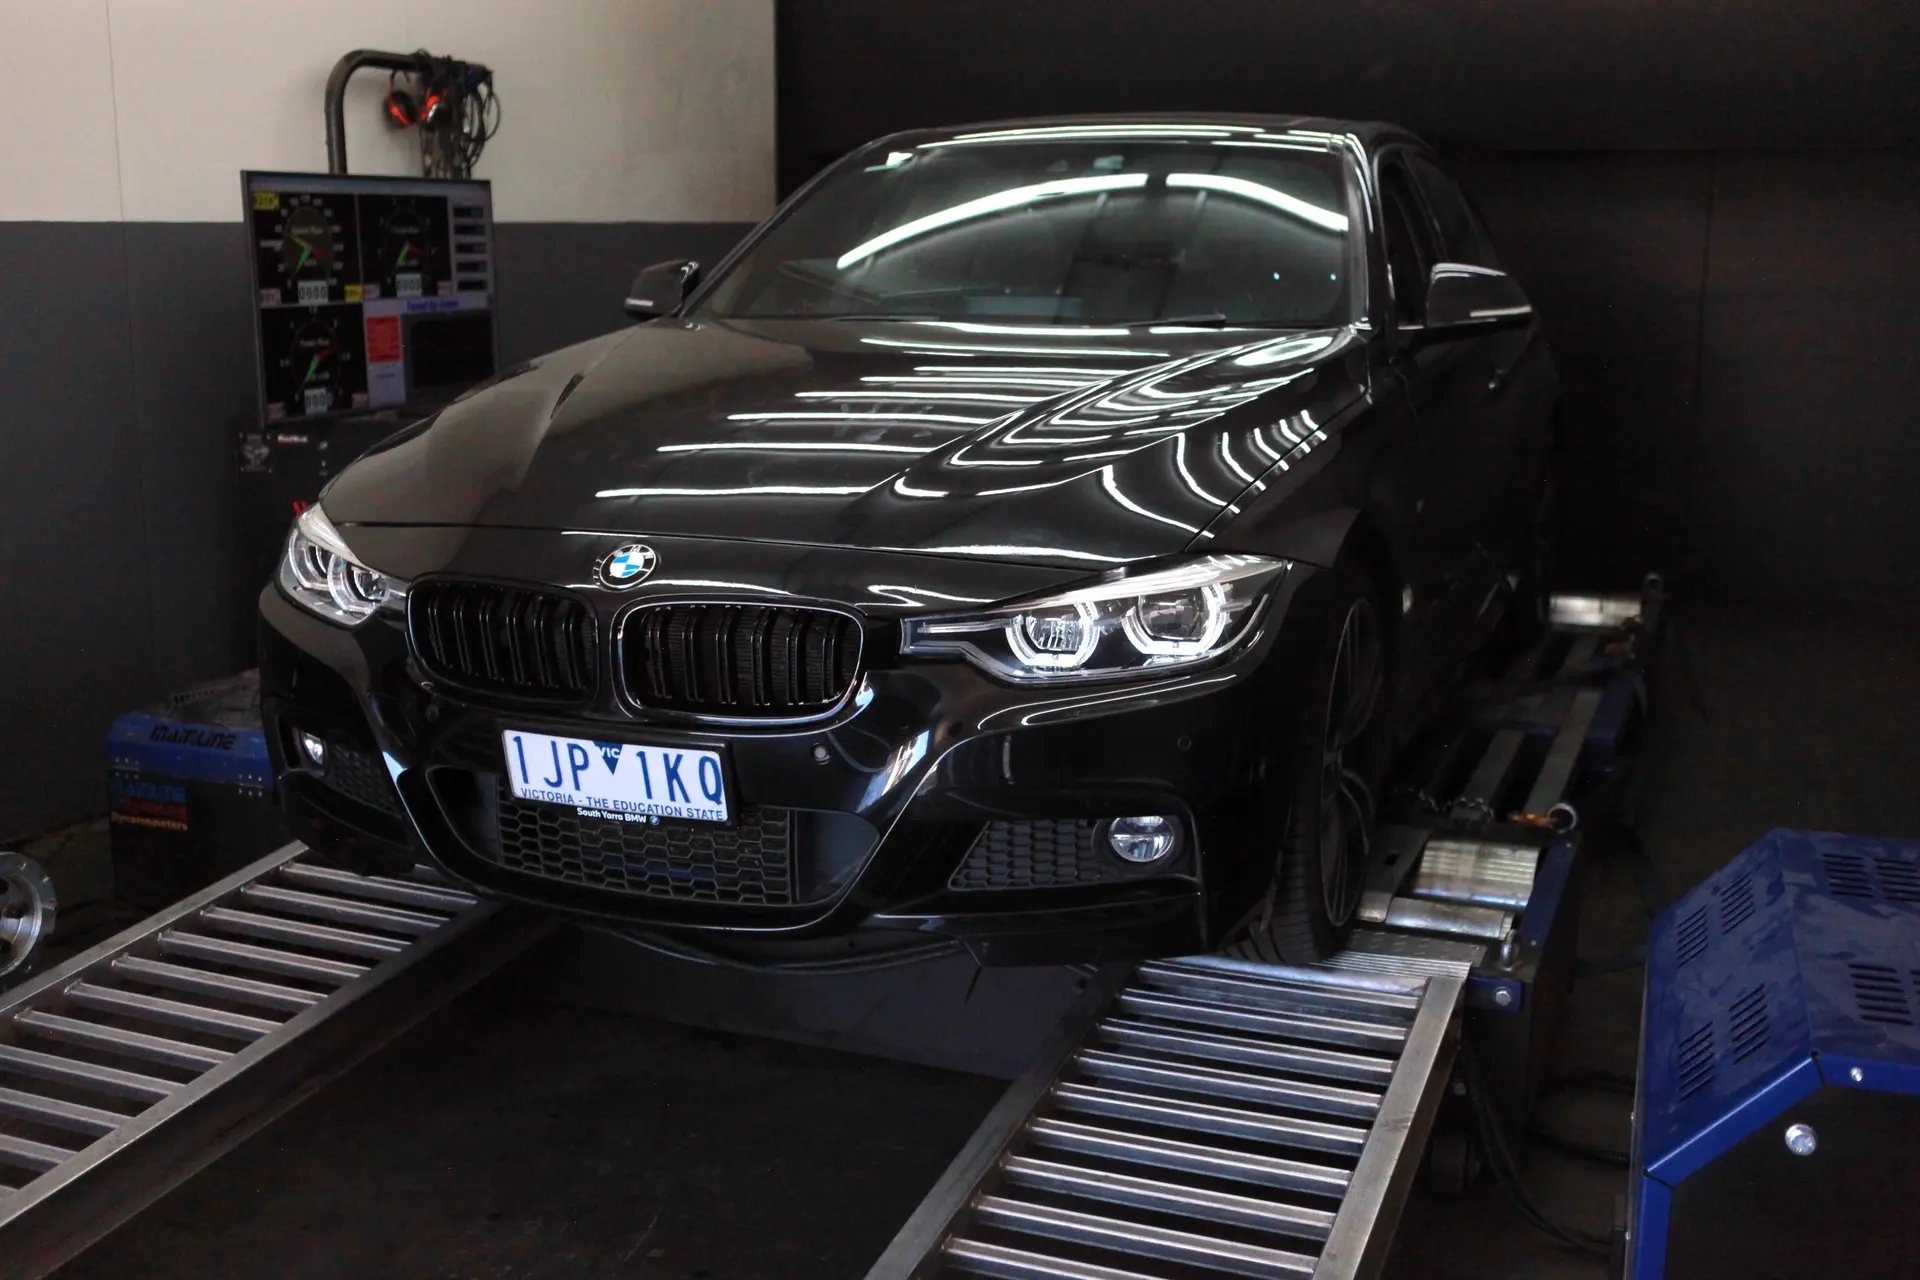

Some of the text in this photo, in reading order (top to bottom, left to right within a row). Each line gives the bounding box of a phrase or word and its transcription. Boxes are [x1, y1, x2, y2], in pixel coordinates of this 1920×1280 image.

[598, 747, 621, 759] VIC
[636, 751, 722, 805] 1KQ
[521, 787, 574, 804] VICTORIA
[586, 796, 609, 808] THE
[614, 800, 682, 817] EDUCATION
[686, 807, 723, 821] STATE
[577, 807, 647, 824] South Yarra BMW
